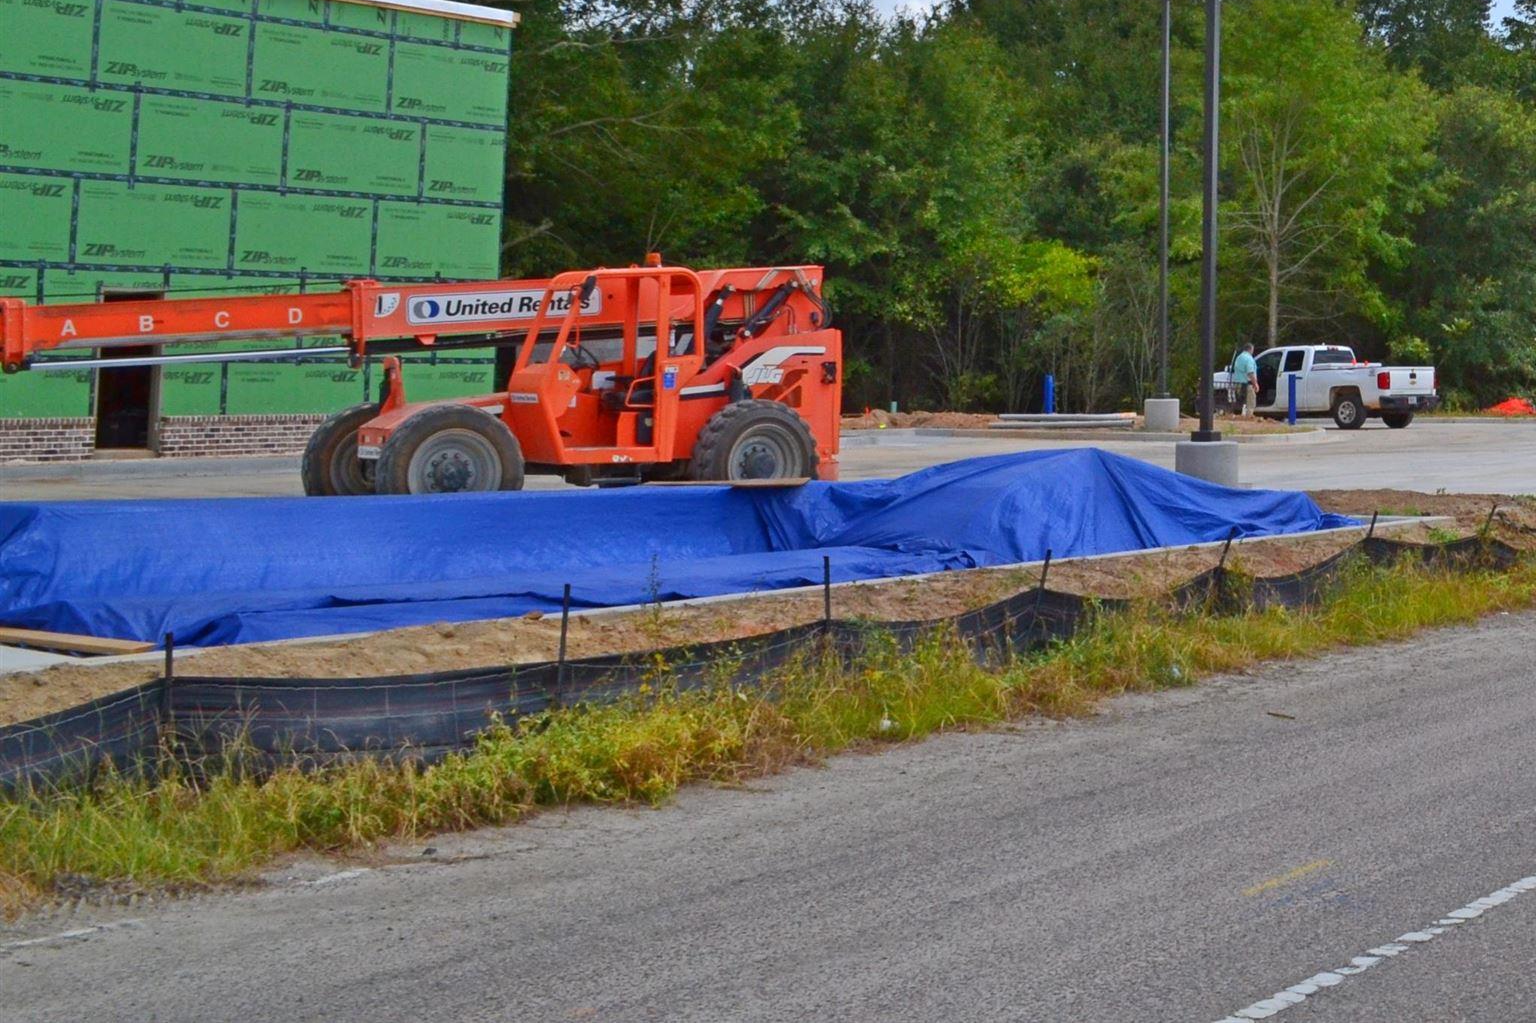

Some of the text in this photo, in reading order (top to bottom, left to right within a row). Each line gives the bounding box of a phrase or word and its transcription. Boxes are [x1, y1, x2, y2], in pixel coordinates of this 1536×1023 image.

[445, 298, 512, 316] United
[61, 308, 302, 336] A B C D
